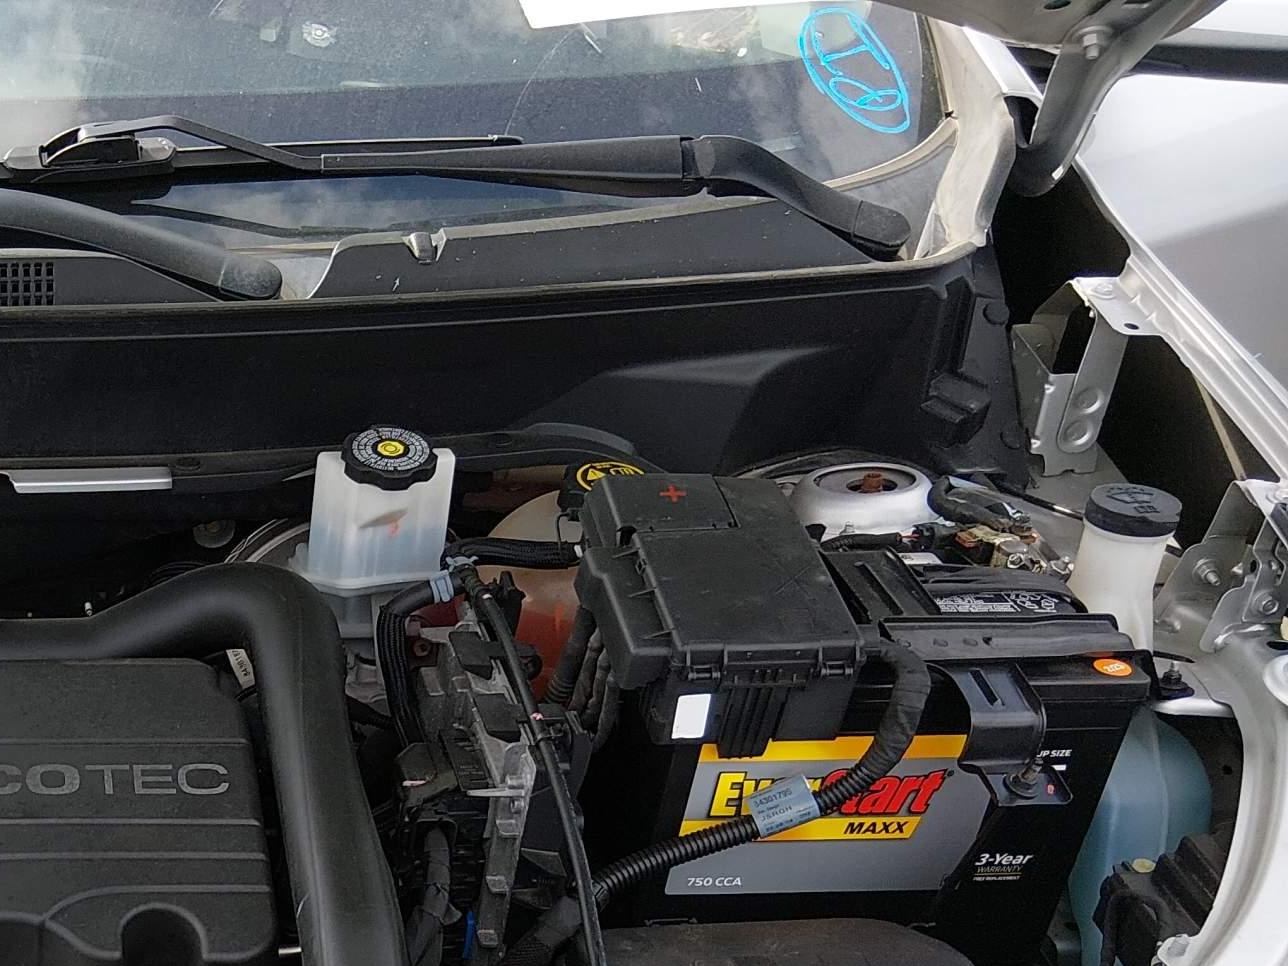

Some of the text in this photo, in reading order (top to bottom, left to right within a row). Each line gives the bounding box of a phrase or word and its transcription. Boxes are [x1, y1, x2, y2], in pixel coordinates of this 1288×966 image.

[1051, 749, 1072, 757] SIZE
[843, 821, 909, 834] MAXX
[974, 853, 1034, 866] 3-Year
[977, 865, 1024, 873] WARRANTY
[687, 876, 742, 887] 750 CCA
